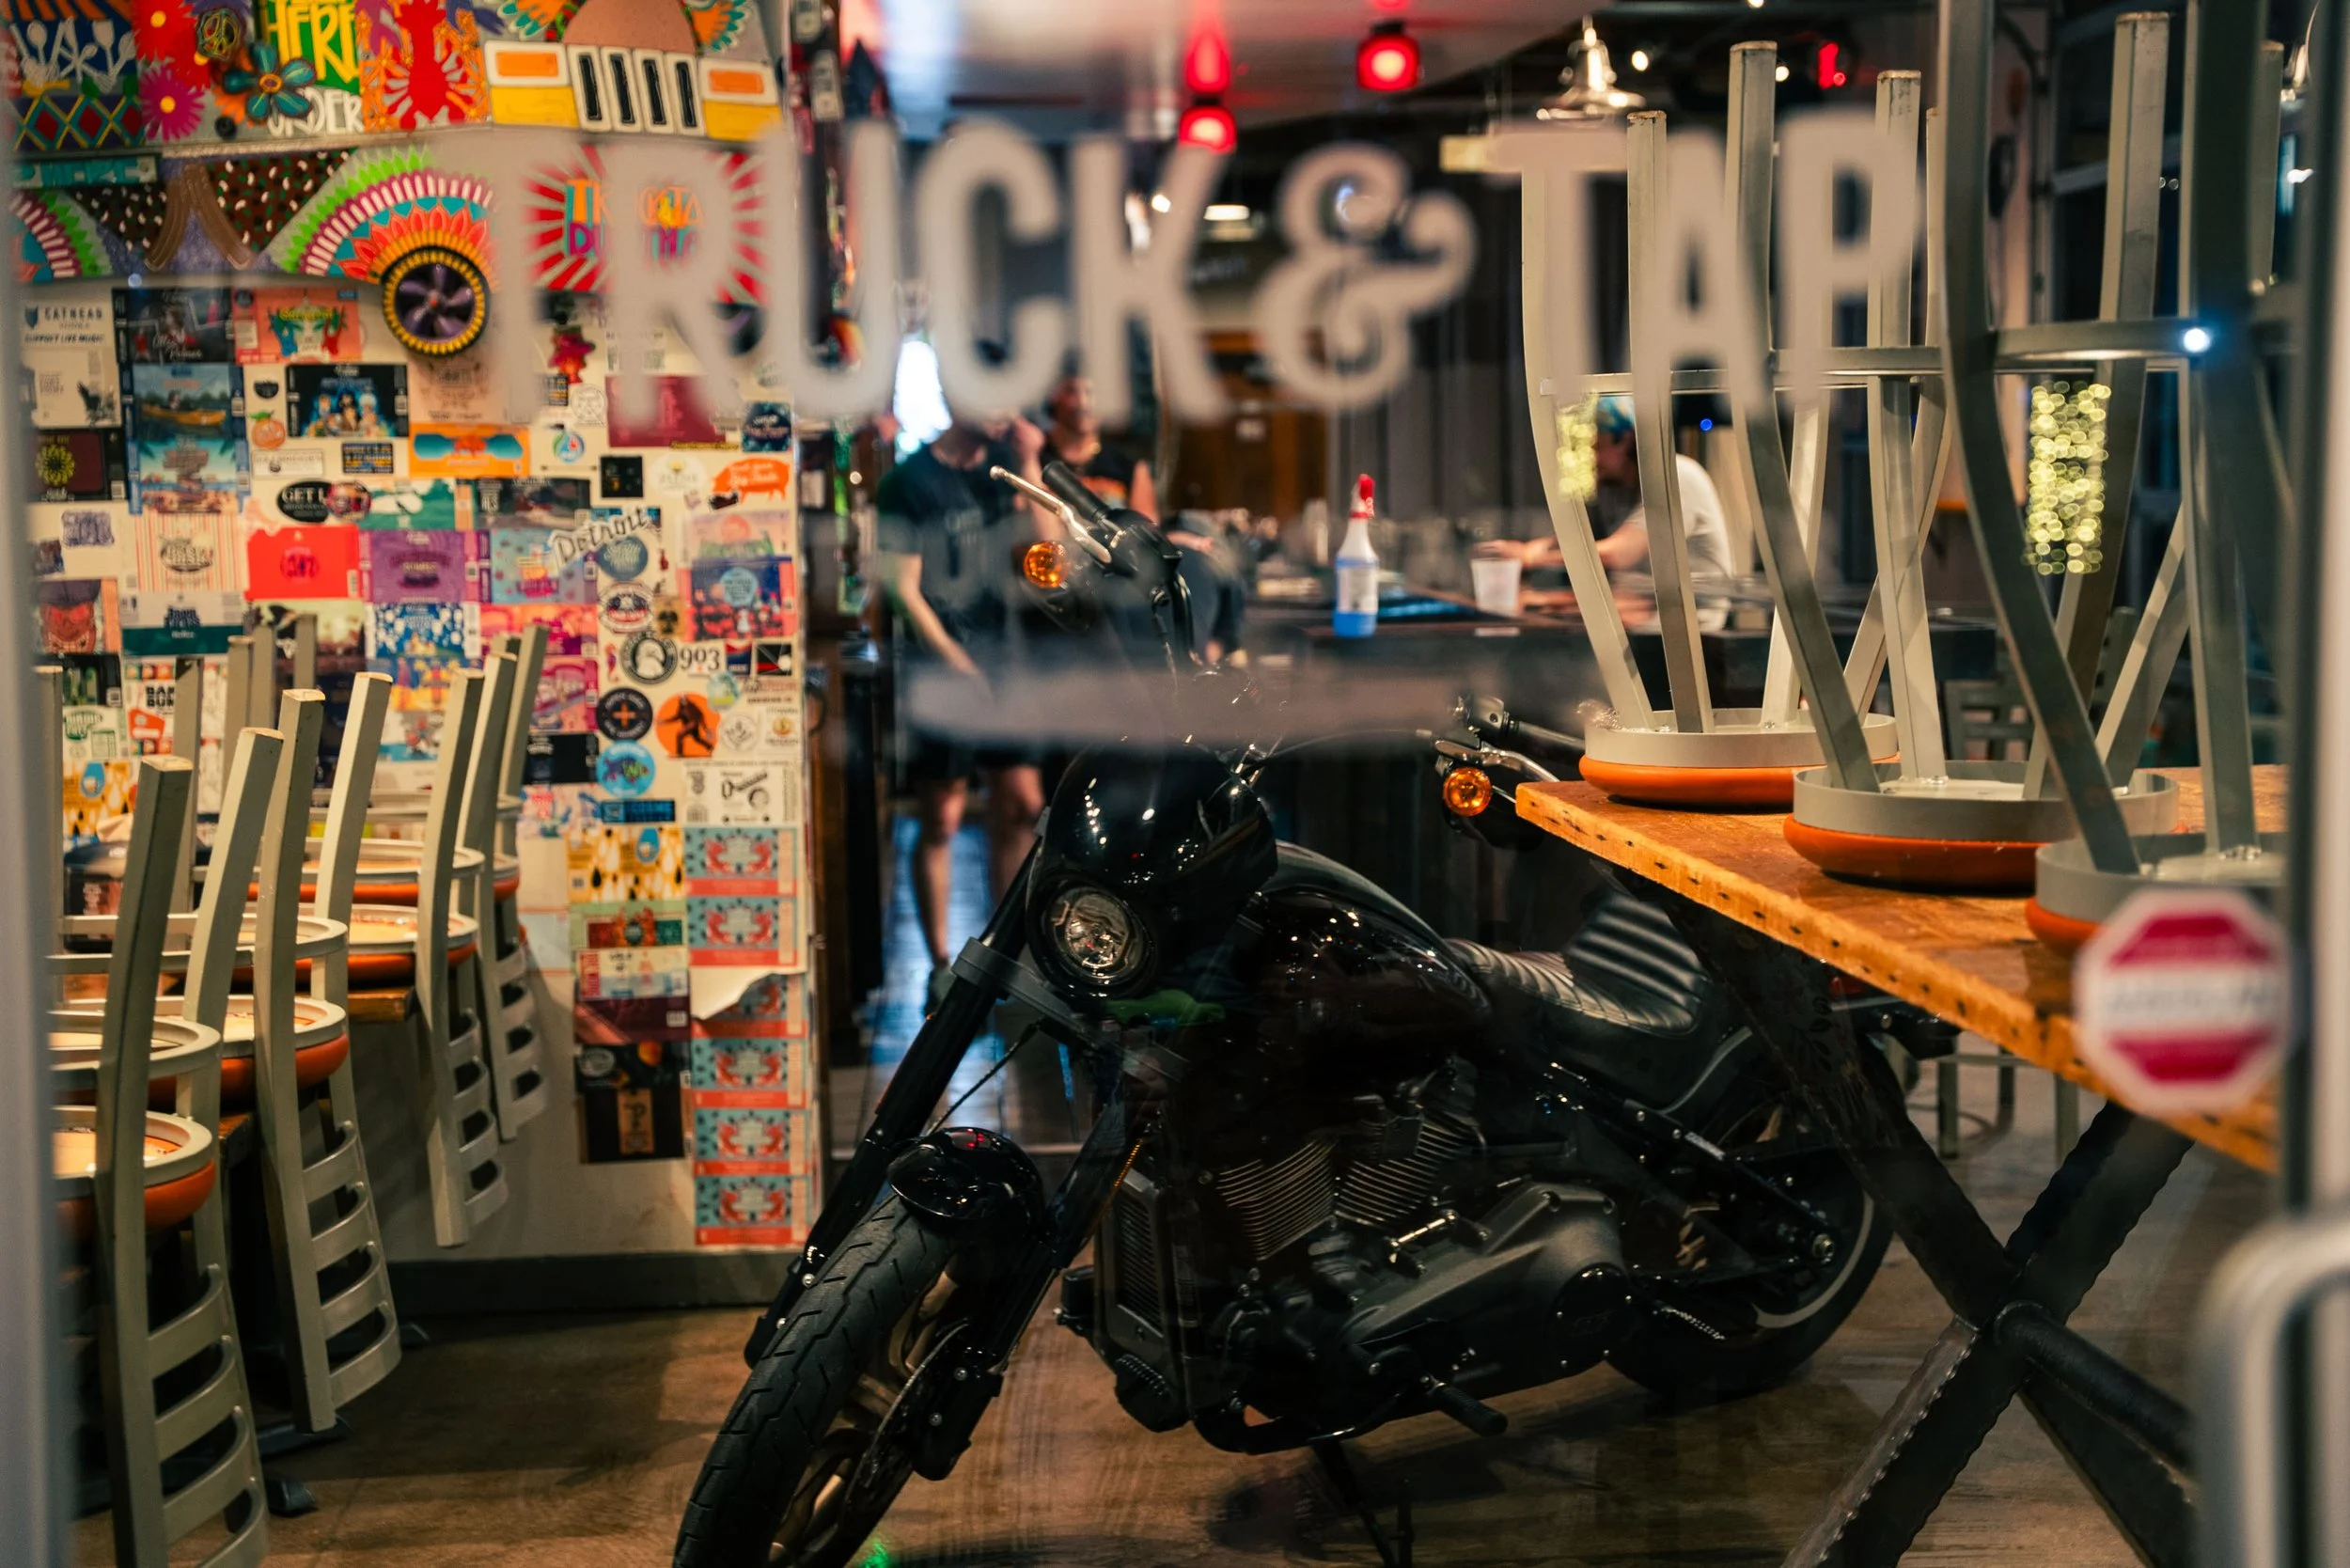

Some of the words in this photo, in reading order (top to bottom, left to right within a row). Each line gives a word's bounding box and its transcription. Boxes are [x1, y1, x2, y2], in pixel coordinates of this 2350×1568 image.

[431, 120, 1233, 423] TRUCK
[1253, 141, 1478, 410] &
[1483, 116, 1923, 422] TAP
[44, 306, 103, 320] CATHEAD
[282, 487, 314, 504] GET
[556, 505, 650, 564] Detroit
[680, 647, 720, 671] 903
